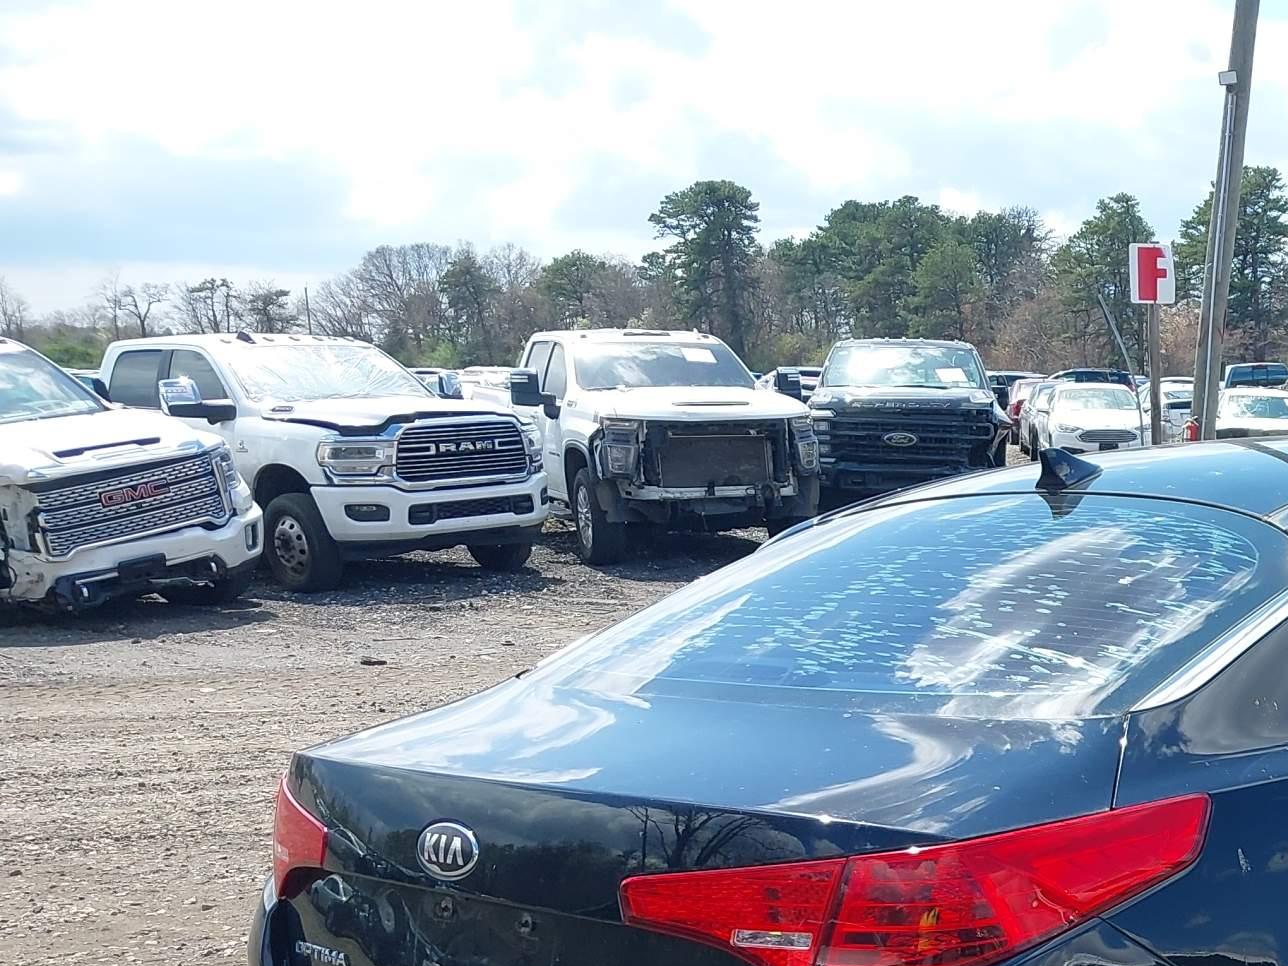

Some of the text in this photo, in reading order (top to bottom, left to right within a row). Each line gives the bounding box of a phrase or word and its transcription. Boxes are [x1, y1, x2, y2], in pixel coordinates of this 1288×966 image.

[1137, 247, 1167, 301] F
[439, 440, 493, 452] RAM
[101, 480, 169, 506] GMC
[424, 832, 464, 866] KIA
